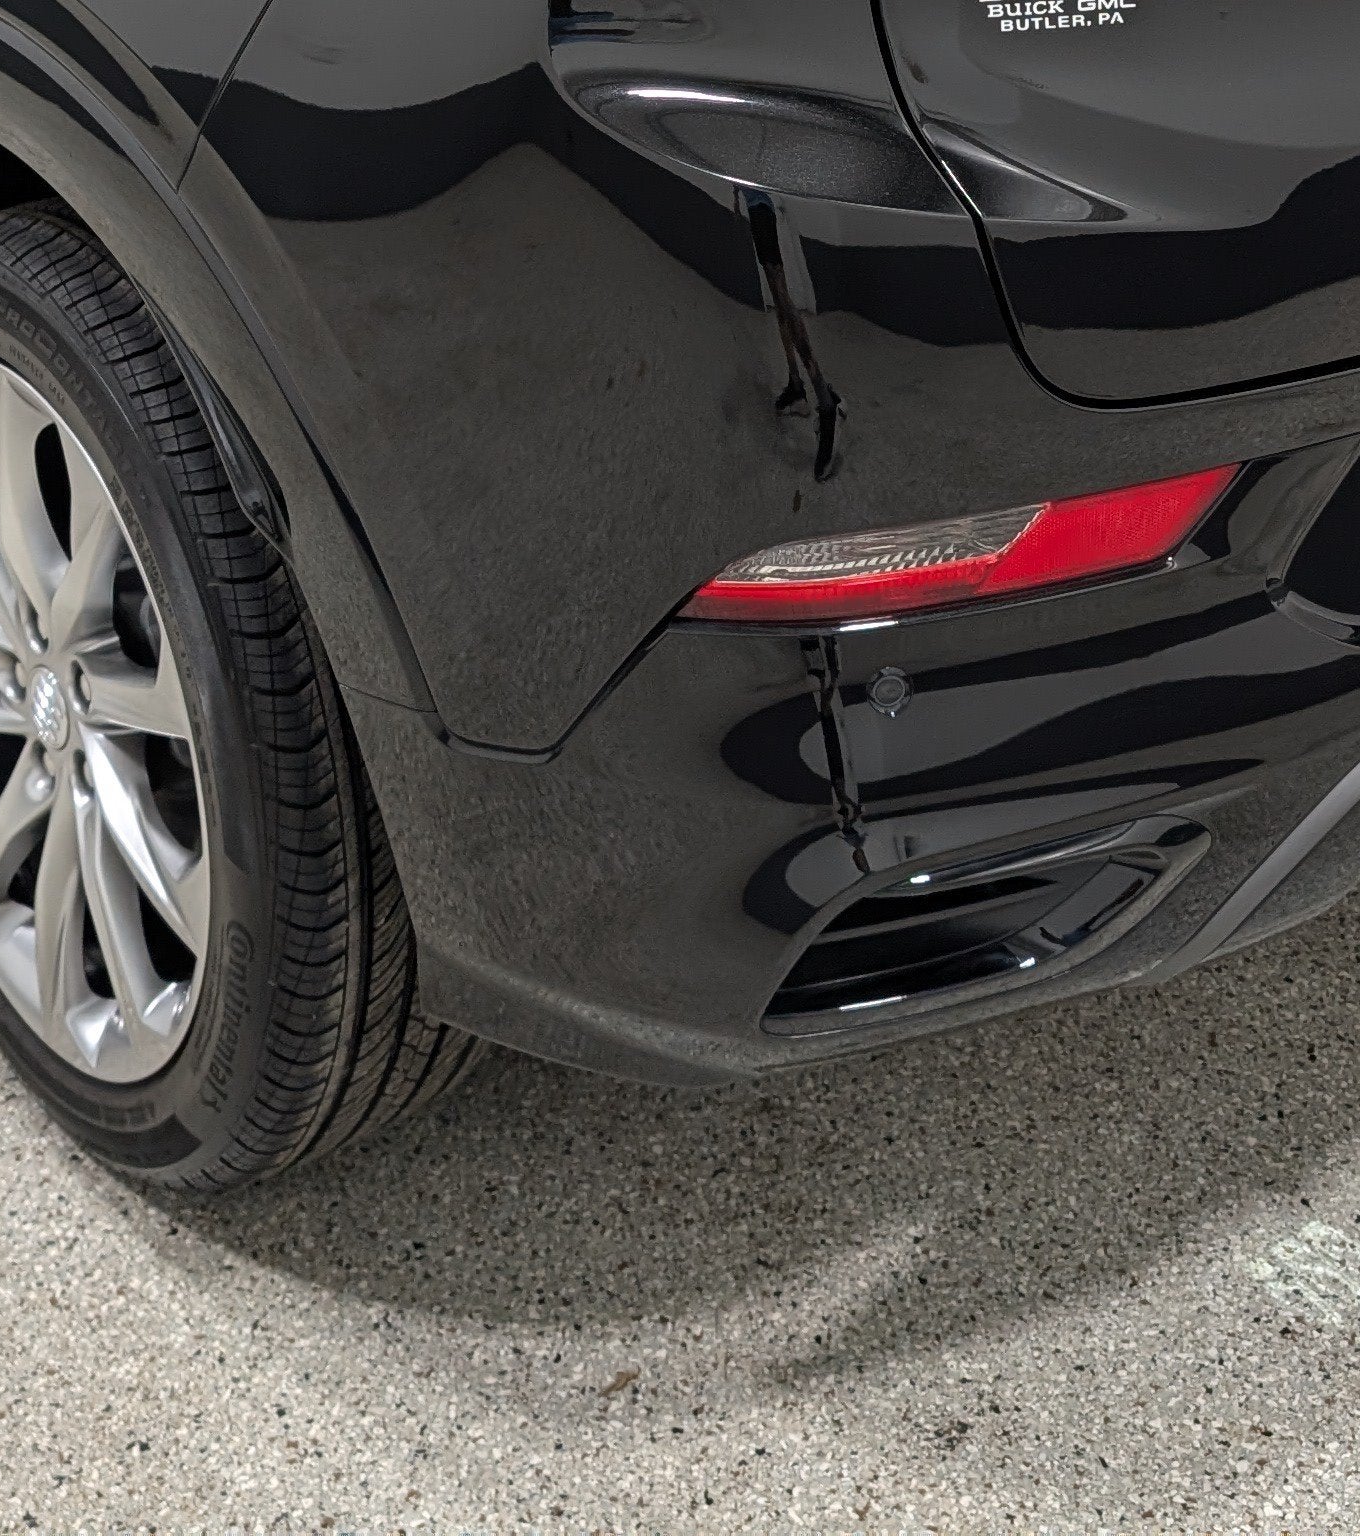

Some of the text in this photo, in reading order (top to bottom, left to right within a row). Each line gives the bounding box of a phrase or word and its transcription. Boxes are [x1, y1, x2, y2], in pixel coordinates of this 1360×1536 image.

[986, 0, 1065, 18] BUICK
[1000, 11, 1124, 32] BUTLER, PA
